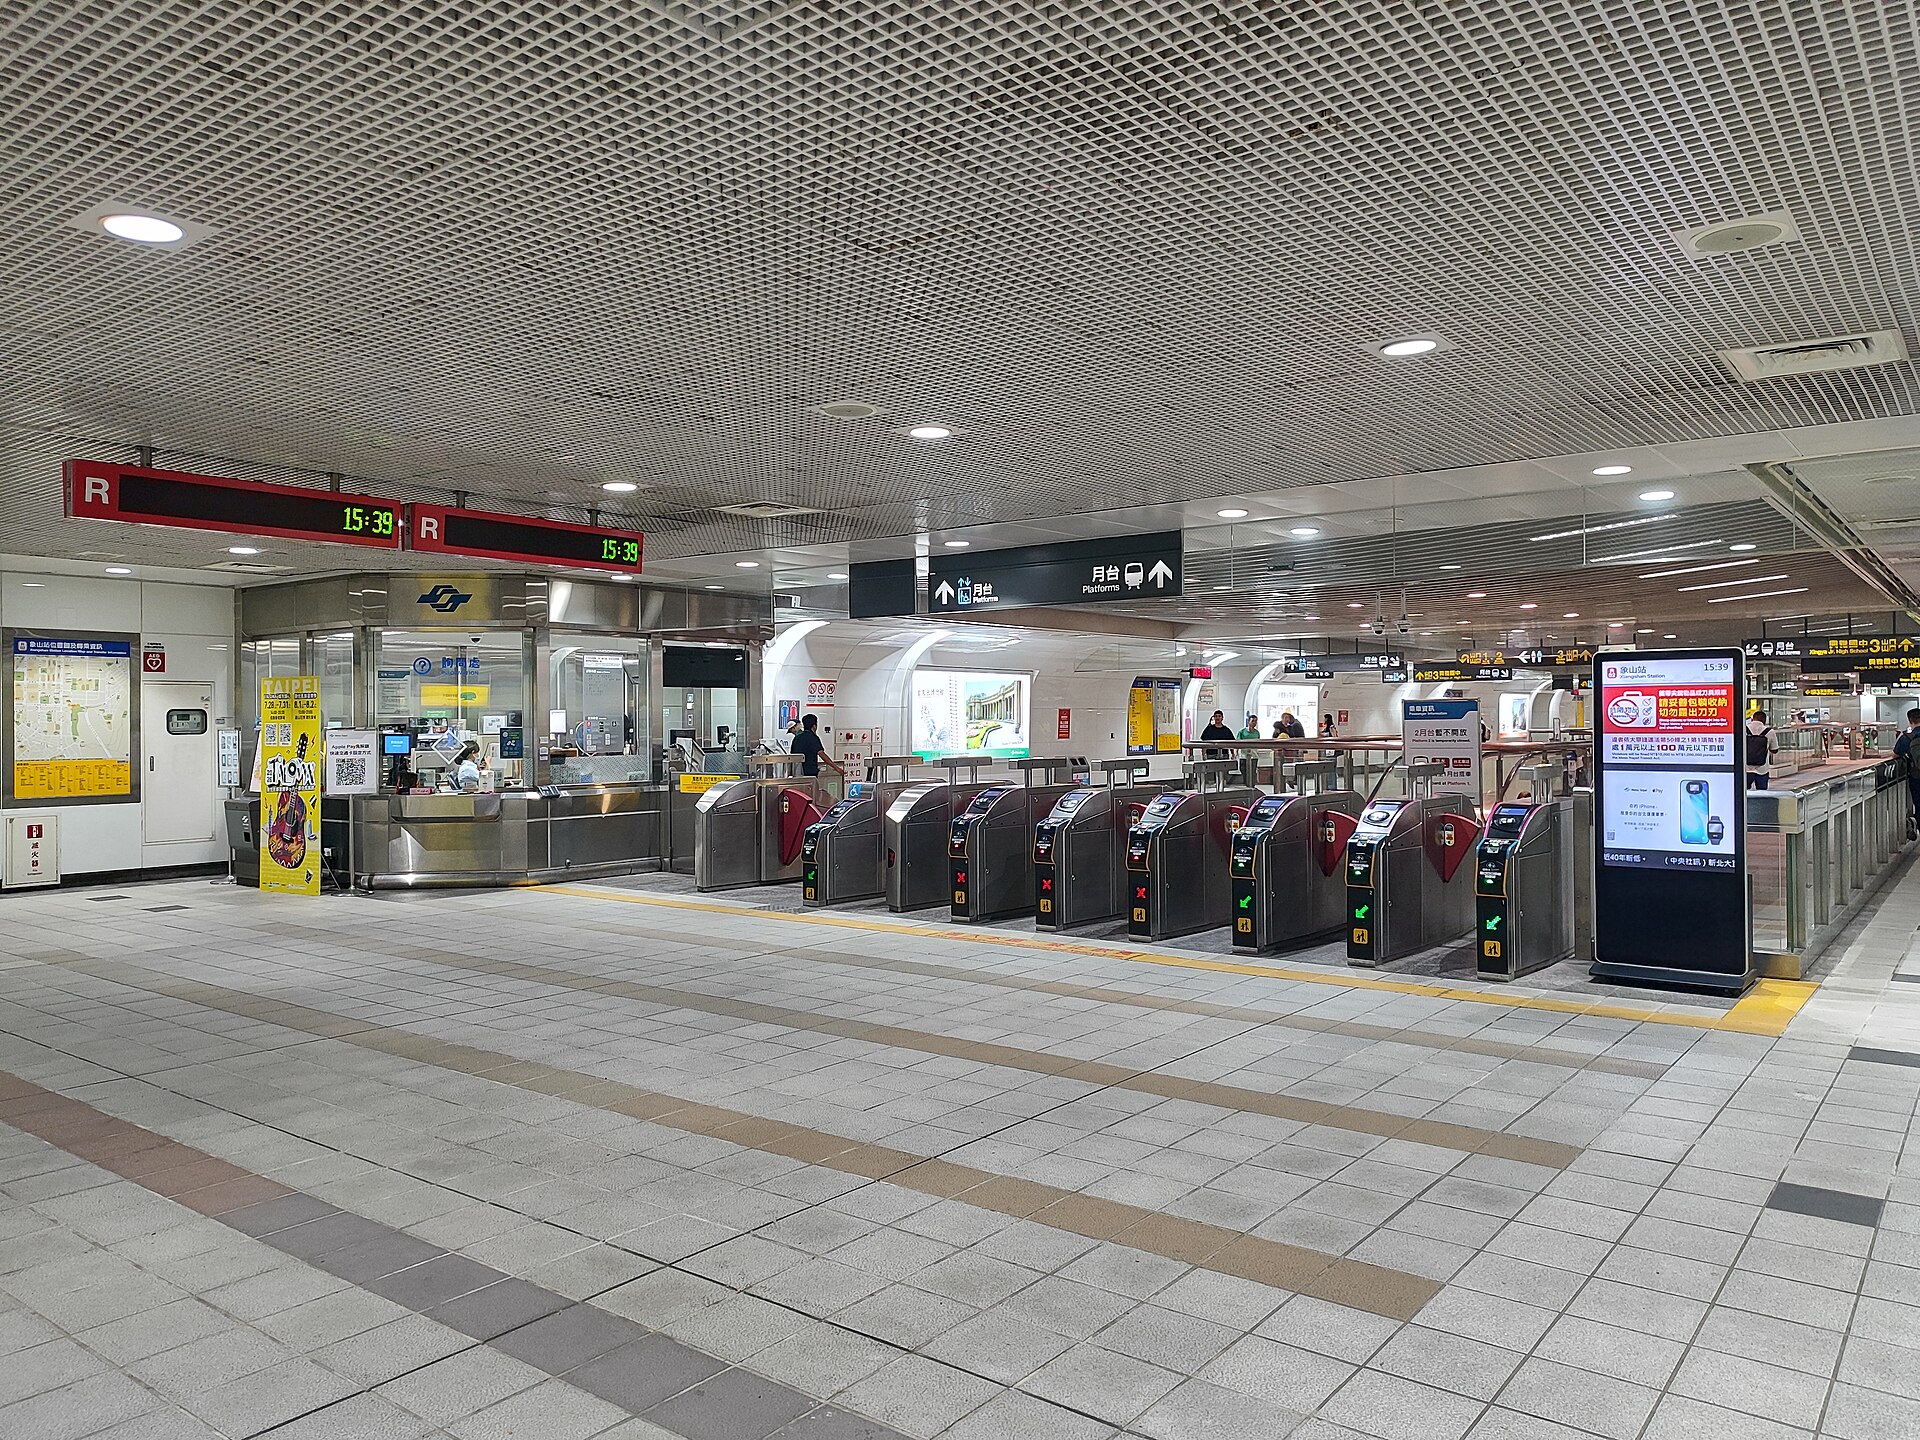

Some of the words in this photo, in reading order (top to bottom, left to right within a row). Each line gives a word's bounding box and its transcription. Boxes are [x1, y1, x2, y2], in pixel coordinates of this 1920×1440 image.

[84, 477, 109, 504] R
[343, 507, 393, 535] 15:39
[420, 517, 439, 540] R
[602, 538, 639, 562] 15:39
[1092, 564, 1120, 582] 月台
[973, 583, 993, 597] 月台
[1082, 584, 1120, 594] Platforms
[973, 596, 999, 604] Platforms
[1776, 641, 1795, 650] 月台
[442, 656, 480, 668] 詢問處
[1703, 663, 1729, 671] 15:39
[1620, 665, 1647, 674] 象山站
[264, 679, 318, 693] TAIPEI
[1658, 697, 1728, 707] 請妥善包裝收納
[1658, 707, 1718, 717] 切勿露出刀刃
[1414, 728, 1468, 737] 2月台暫不開放
